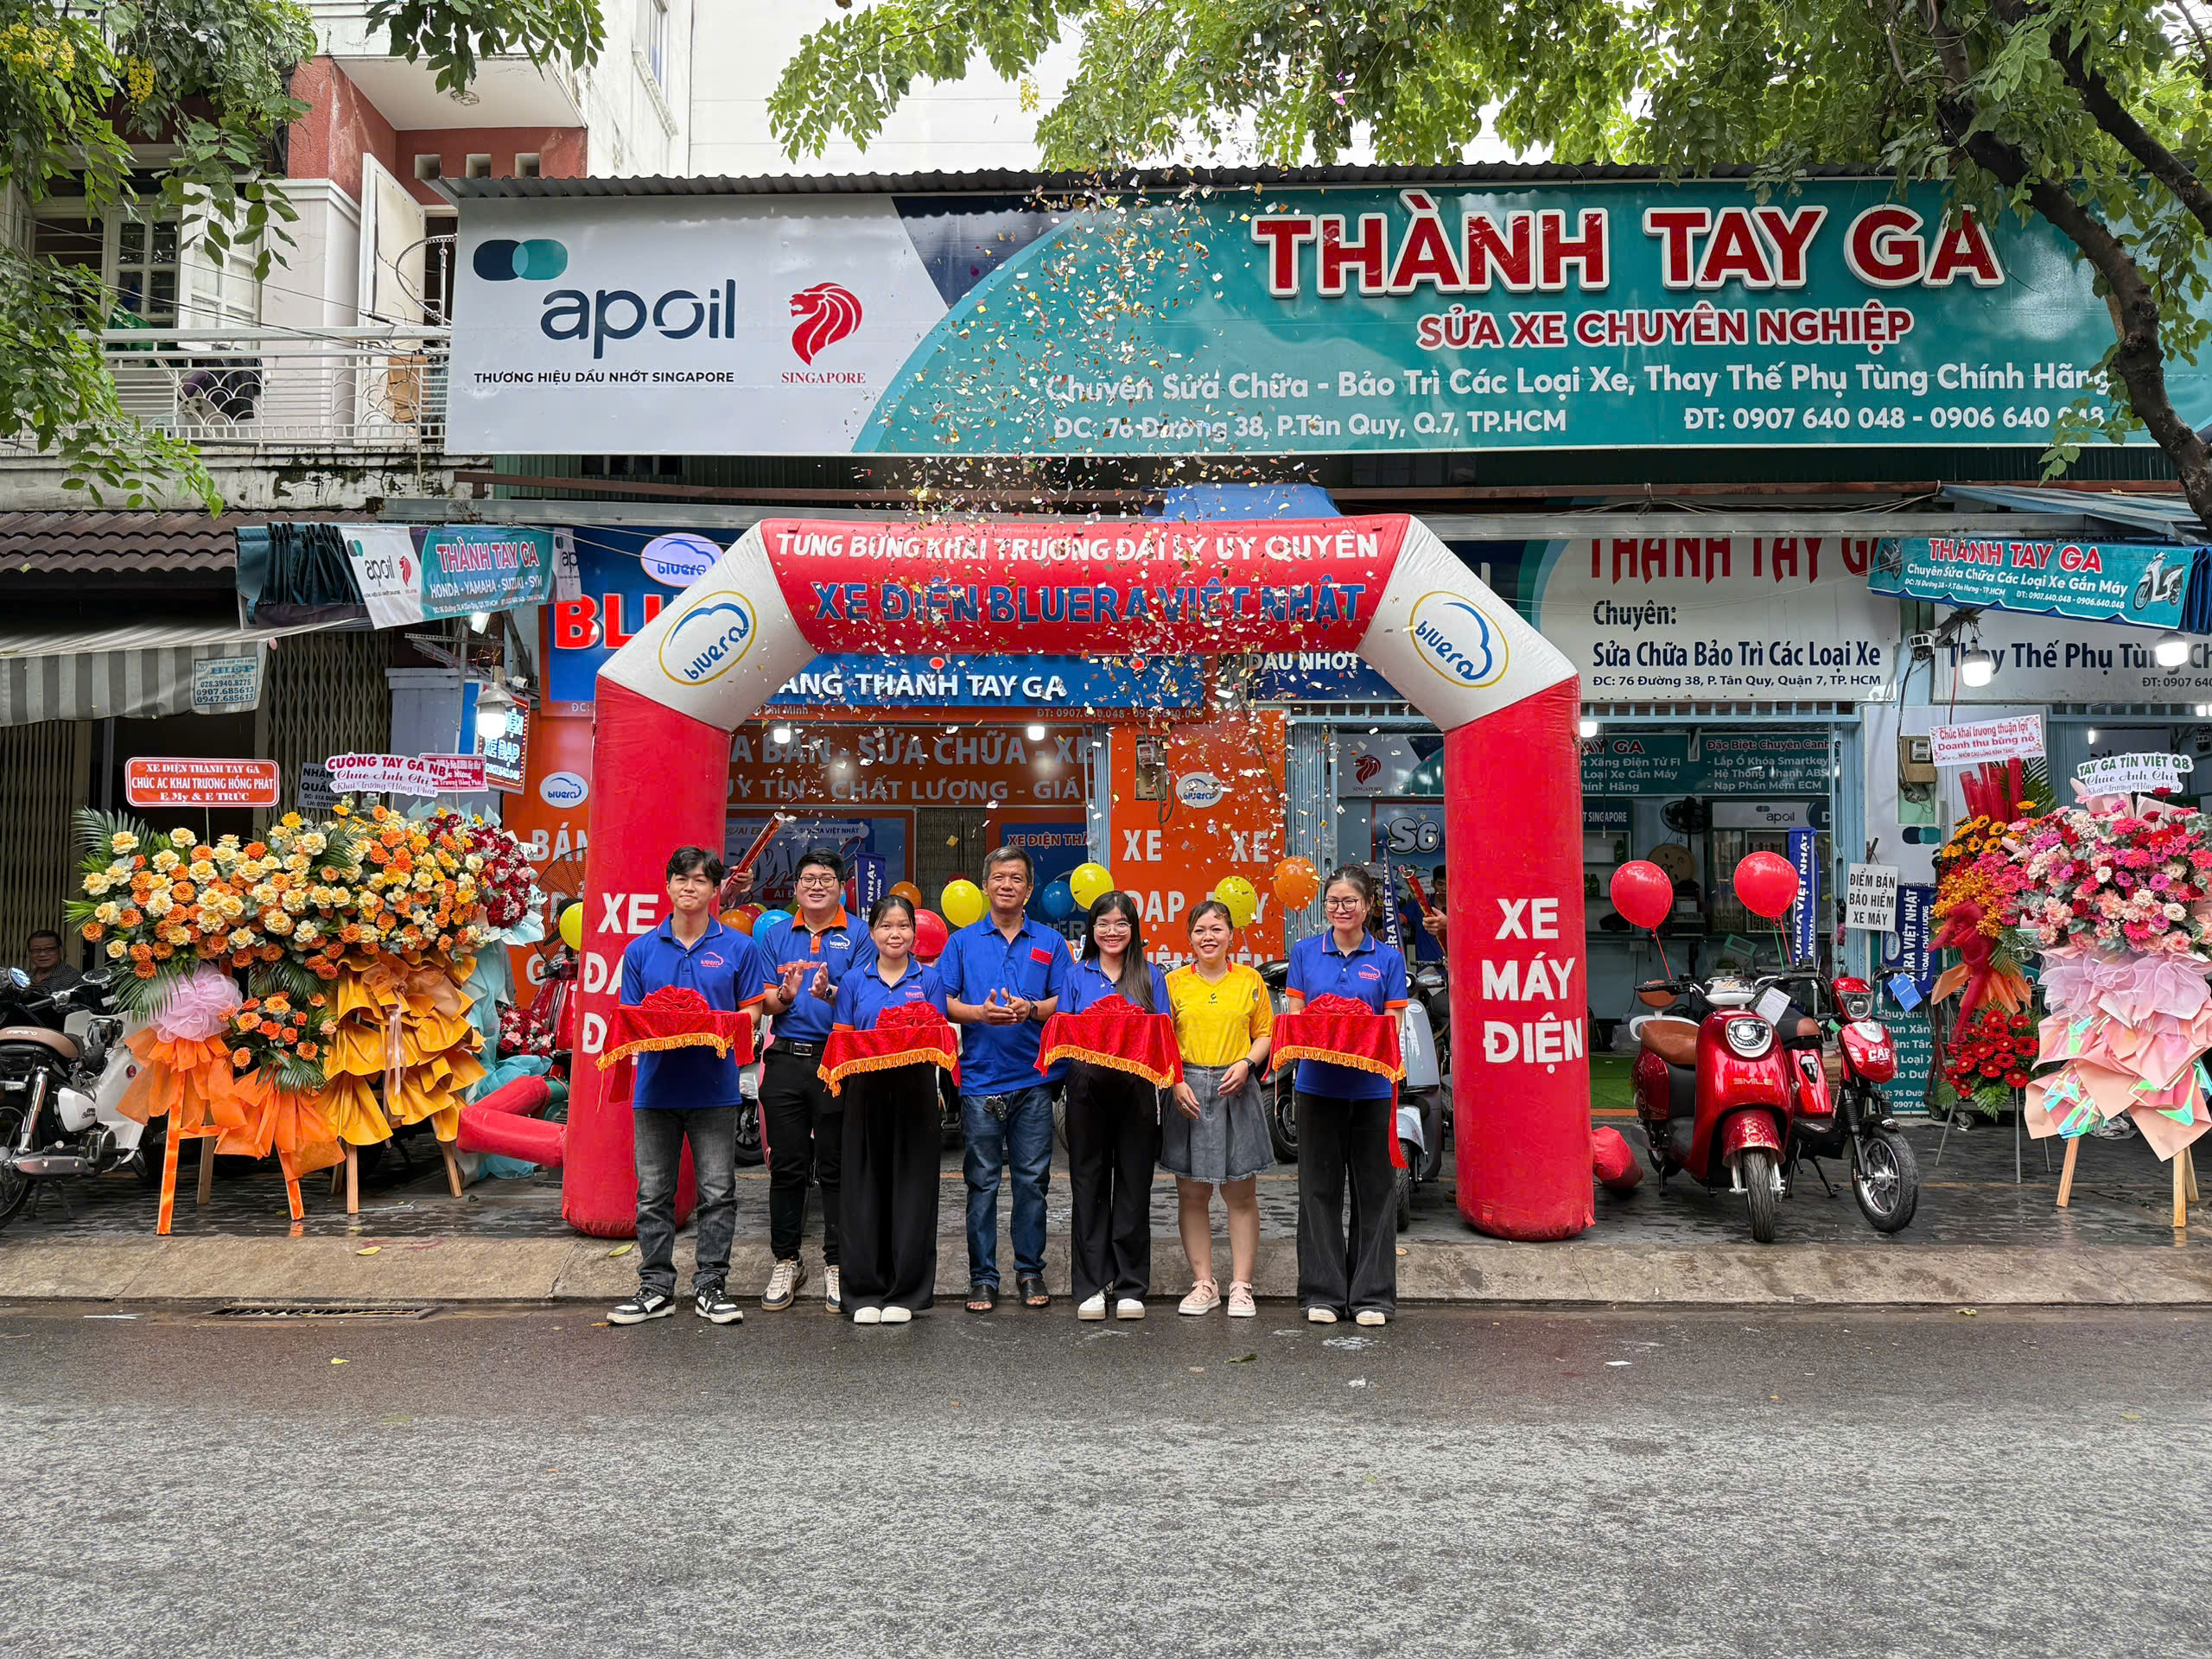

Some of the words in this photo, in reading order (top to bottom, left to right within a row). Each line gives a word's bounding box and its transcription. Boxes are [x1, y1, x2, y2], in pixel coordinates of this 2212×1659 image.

[1251, 188, 1611, 298] THÀNH
[1643, 206, 1827, 289] TAY
[1844, 204, 2005, 289] GA
[541, 279, 735, 359] apoil
[1417, 303, 1503, 351] SỬA
[1508, 309, 1567, 349] XE
[1573, 299, 1749, 347] CHUYÊN
[1756, 298, 1914, 353] NGHIỆP
[474, 370, 533, 383] THƯƠNG
[538, 370, 571, 387] HIỆU
[575, 369, 604, 383] DẦU
[609, 370, 648, 383] NHỚT
[652, 372, 734, 383] SINGAPORE
[781, 372, 865, 384] SINGAPORE
[1045, 373, 1154, 405] Chuyên
[1163, 371, 1219, 399] Sửa
[1229, 372, 1308, 399] Chữa
[1338, 369, 1395, 397] Bảo
[1403, 368, 1440, 396] Trì
[1449, 367, 1507, 395] Các
[1516, 366, 1580, 401] Loại
[1589, 366, 1636, 397] Xe,
[1644, 365, 1718, 397] Thay
[1726, 361, 1782, 391] Thế
[1792, 363, 1847, 398] Phụ
[1856, 365, 1929, 396] Tùng
[1937, 362, 2024, 389] Chính
[2034, 363, 2109, 396] Hãng
[1235, 416, 1271, 440] 38,
[1277, 414, 1341, 436] P.Tân
[1349, 412, 1404, 440] Quy,
[1414, 411, 1459, 437] Q.7,
[1467, 409, 1567, 433] TP.HCM
[1683, 408, 1725, 430] ĐT:
[1733, 408, 1795, 429] 0907
[1802, 408, 1851, 429] 640
[1858, 408, 1905, 429] 048
[1930, 406, 1994, 429] 0906
[2003, 407, 2050, 428] 640
[435, 537, 492, 573] THÀNH
[492, 542, 518, 569] TAY
[520, 541, 539, 567] GA
[925, 535, 987, 560] KHAI
[1264, 529, 1378, 562] QUYỀN
[1929, 537, 2003, 569] THÀNH
[2009, 542, 2053, 570] TAY
[2059, 545, 2102, 575] GA
[365, 555, 395, 587] apoil
[1907, 563, 1943, 579] Chuyên
[1943, 566, 1963, 579] Sửa
[1965, 567, 1994, 583] Chữa
[1997, 571, 2018, 584] Các
[2021, 574, 2046, 590] Loại
[2048, 575, 2065, 588] Xe
[2069, 575, 2102, 593] Gắn
[2104, 579, 2128, 597] Máy
[430, 582, 460, 598] HONDA
[464, 579, 496, 596] YAMAHA
[810, 582, 867, 620] XE
[1260, 574, 1366, 629] NHẬT
[1593, 600, 1677, 632] Chuyên:
[684, 626, 748, 681] bluera
[1414, 620, 1475, 680] bluera
[1593, 640, 1630, 667] Sửa
[1637, 640, 1687, 666] Chữa
[1694, 639, 1732, 666] Bảo
[1738, 640, 1763, 666] Trì
[1770, 640, 1802, 666] Các
[1809, 641, 1850, 673] Loại
[1856, 643, 1880, 666] Xe
[2012, 639, 2057, 668] Thế
[2065, 643, 2112, 675] Phụ
[967, 675, 1018, 696] TAY
[1022, 675, 1067, 698] GA
[1593, 677, 1616, 686] ĐC:
[1619, 677, 1634, 686] 76
[1638, 674, 1681, 689] Đường
[1685, 676, 1704, 688] 38,
[1720, 675, 1743, 686] Tân
[1745, 676, 1774, 689] Quy,
[1778, 675, 1812, 689] Quận
[1830, 677, 1848, 685] TP.
[1851, 676, 1880, 685] HCM
[2142, 677, 2160, 687] ĐT:
[2163, 677, 2191, 687] 0907
[571, 703, 590, 712] ĐC:
[1037, 709, 1053, 717] ĐT:
[934, 728, 1027, 765] CHỮA
[1612, 740, 1645, 753] GA
[1758, 739, 1801, 752] Chuyên
[1939, 741, 1969, 750] Doanh
[146, 763, 160, 772] XE
[226, 764, 244, 773] TAY
[245, 765, 259, 774] GA
[382, 757, 404, 768] TAY
[408, 760, 424, 772] GA
[429, 764, 446, 778] NB
[1623, 757, 1649, 768] Điện
[1654, 770, 1677, 780] Máy
[1777, 757, 1828, 766] Smartkey
[2079, 762, 2097, 776] TAY
[2101, 759, 2116, 772] GA
[2120, 753, 2139, 768] TÍN
[2143, 753, 2167, 770] VIỆT
[2172, 757, 2190, 770] Q8
[131, 775, 155, 789] CHÚC
[157, 778, 168, 789] AC
[169, 778, 190, 789] KHAI
[228, 775, 252, 789] HỒNG
[253, 776, 274, 789] PHÁT
[912, 779, 1008, 805] LƯỢNG
[1033, 777, 1080, 798] GIÁ
[1610, 782, 1639, 792] Hãng
[173, 792, 188, 802] My
[216, 791, 249, 801] TRÚC
[1589, 811, 1627, 822] SINGAPORE
[1766, 812, 1795, 823] apoil
[1007, 834, 1026, 846] XE
[1028, 831, 1060, 849] ĐIỆN
[1123, 830, 1162, 861] XE
[1230, 830, 1268, 862] XE
[1387, 817, 1440, 854] S6
[1800, 833, 1809, 875] NHẬT
[868, 861, 876, 902] NHẬT
[1850, 868, 1872, 887] ĐIỂM
[1876, 873, 1895, 889] BÁN
[1849, 889, 1867, 906] BẢO
[1871, 890, 1894, 908] HIỂM
[1904, 889, 1920, 922] NHẬT
[597, 893, 659, 934] XE
[1495, 898, 1559, 940] XE
[1853, 911, 1865, 924] XE
[1868, 910, 1888, 926] MÁY
[1902, 923, 1919, 950] VIỆT
[1481, 951, 1576, 1001] MÁY
[1483, 1012, 1583, 1074] ĐIỆN
